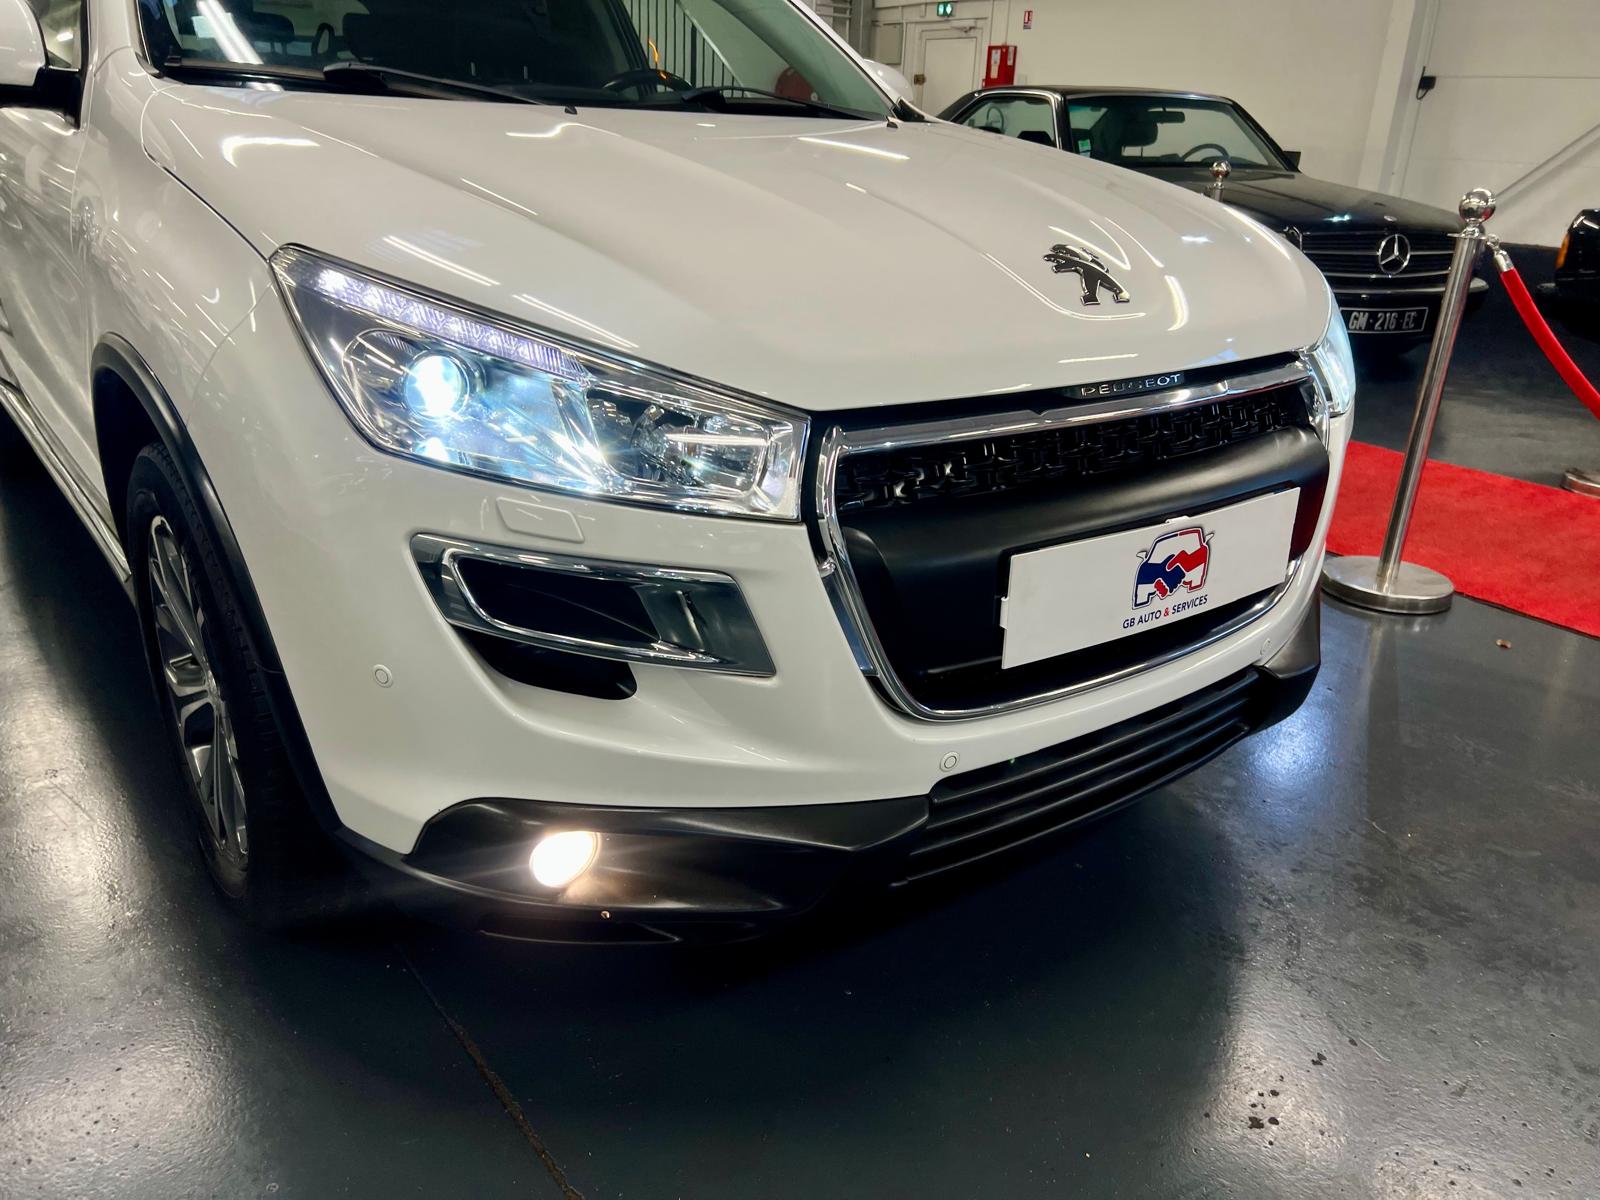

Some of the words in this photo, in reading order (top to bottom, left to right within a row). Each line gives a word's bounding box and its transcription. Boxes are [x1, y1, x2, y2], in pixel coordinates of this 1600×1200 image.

[1122, 617, 1136, 629] GB
[1137, 609, 1162, 625] AUTO
[1163, 607, 1170, 617] &
[1171, 594, 1208, 614] SERVICES
